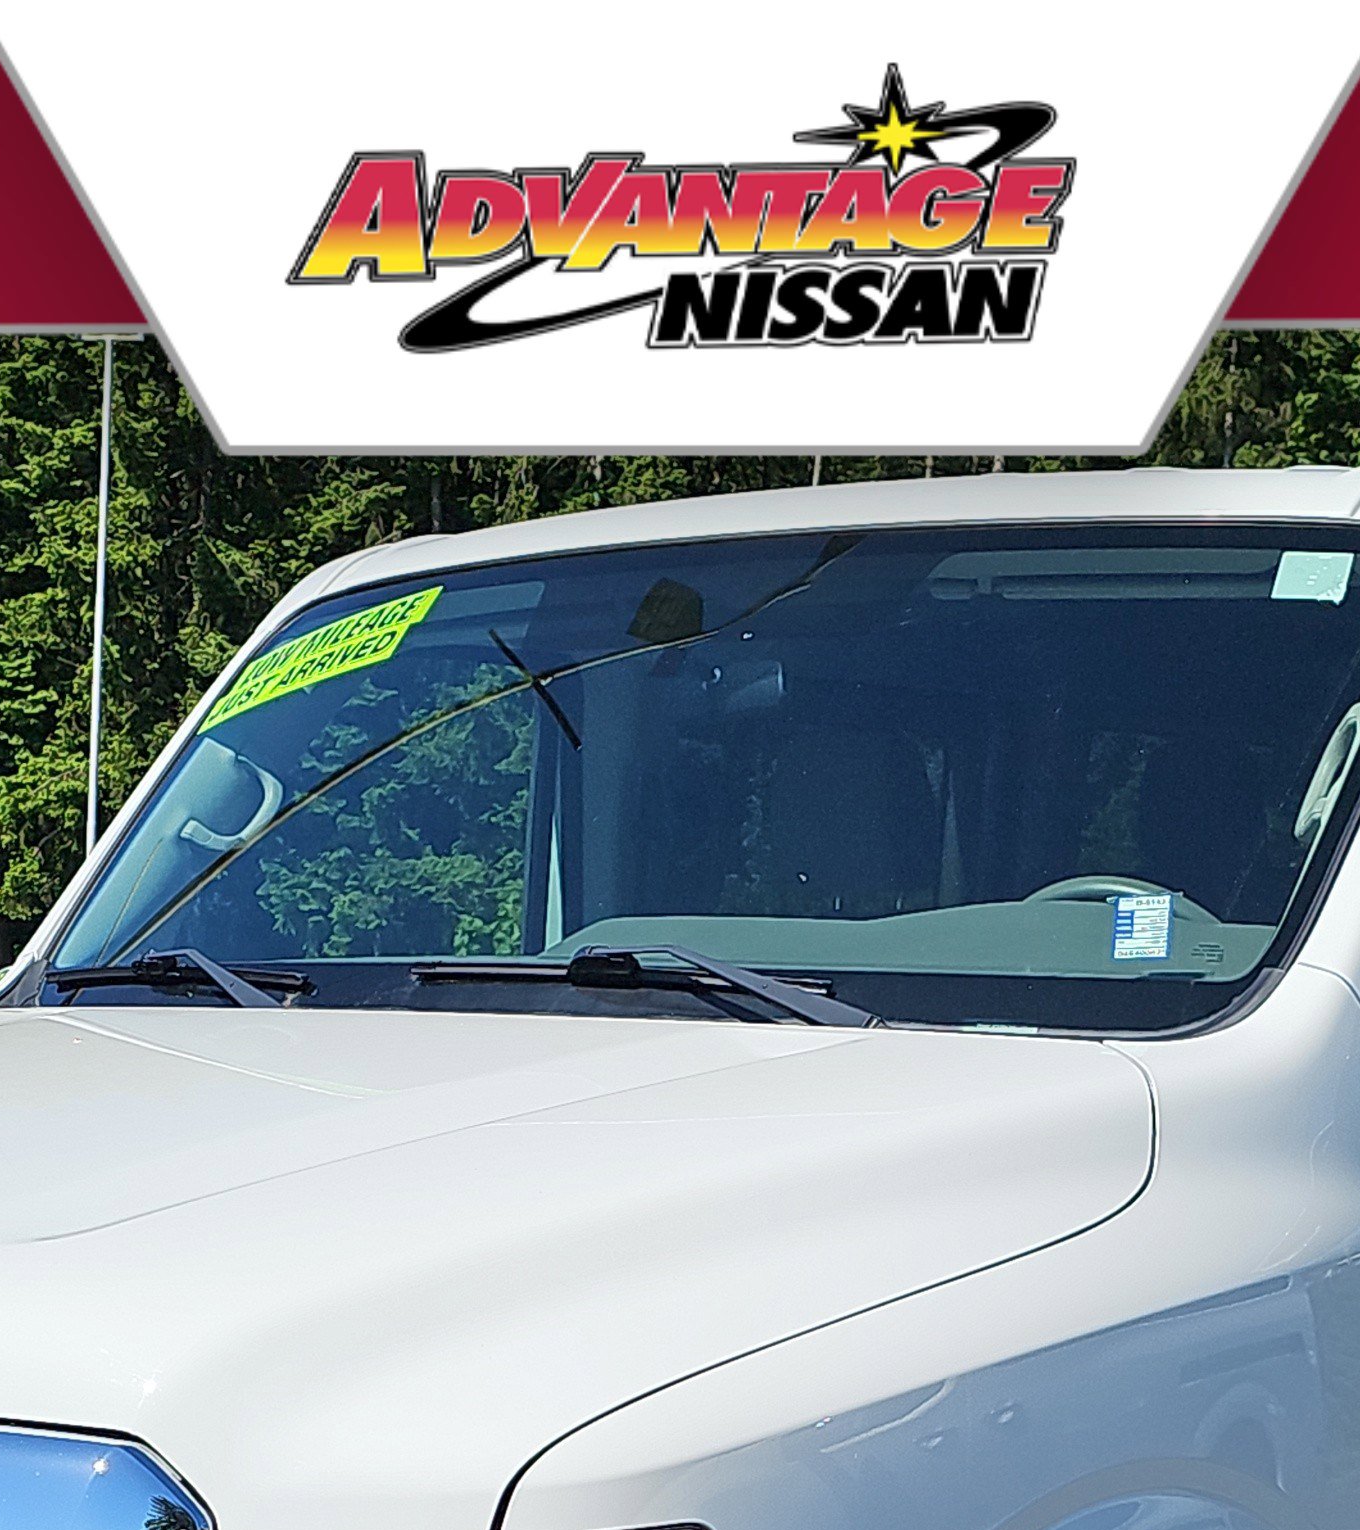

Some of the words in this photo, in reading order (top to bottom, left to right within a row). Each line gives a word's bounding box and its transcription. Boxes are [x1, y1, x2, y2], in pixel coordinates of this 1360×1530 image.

[294, 594, 426, 664] MILEAGE
[208, 673, 280, 722] JUST
[270, 630, 398, 695] ARRIVED
